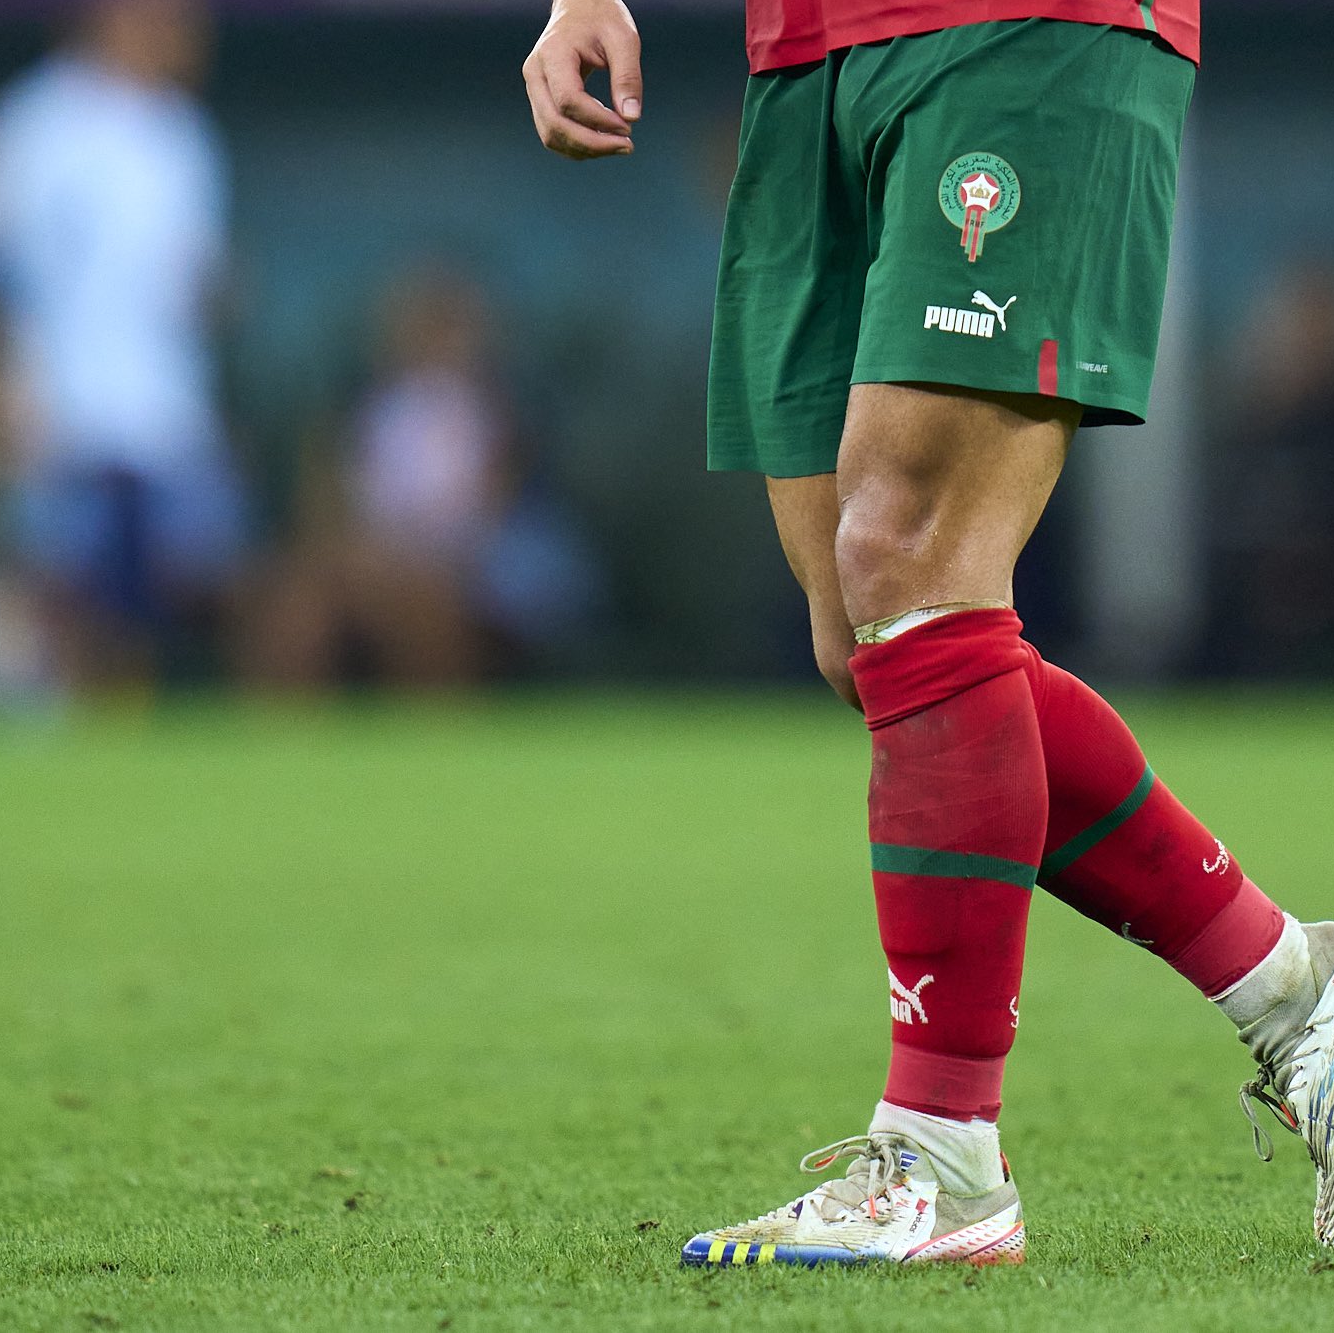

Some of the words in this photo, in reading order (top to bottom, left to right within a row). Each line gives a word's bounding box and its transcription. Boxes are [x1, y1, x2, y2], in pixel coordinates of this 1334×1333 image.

[955, 155, 991, 168] المغربية
[1002, 189, 1018, 220] الجامعة
[923, 305, 995, 338] PUMA
